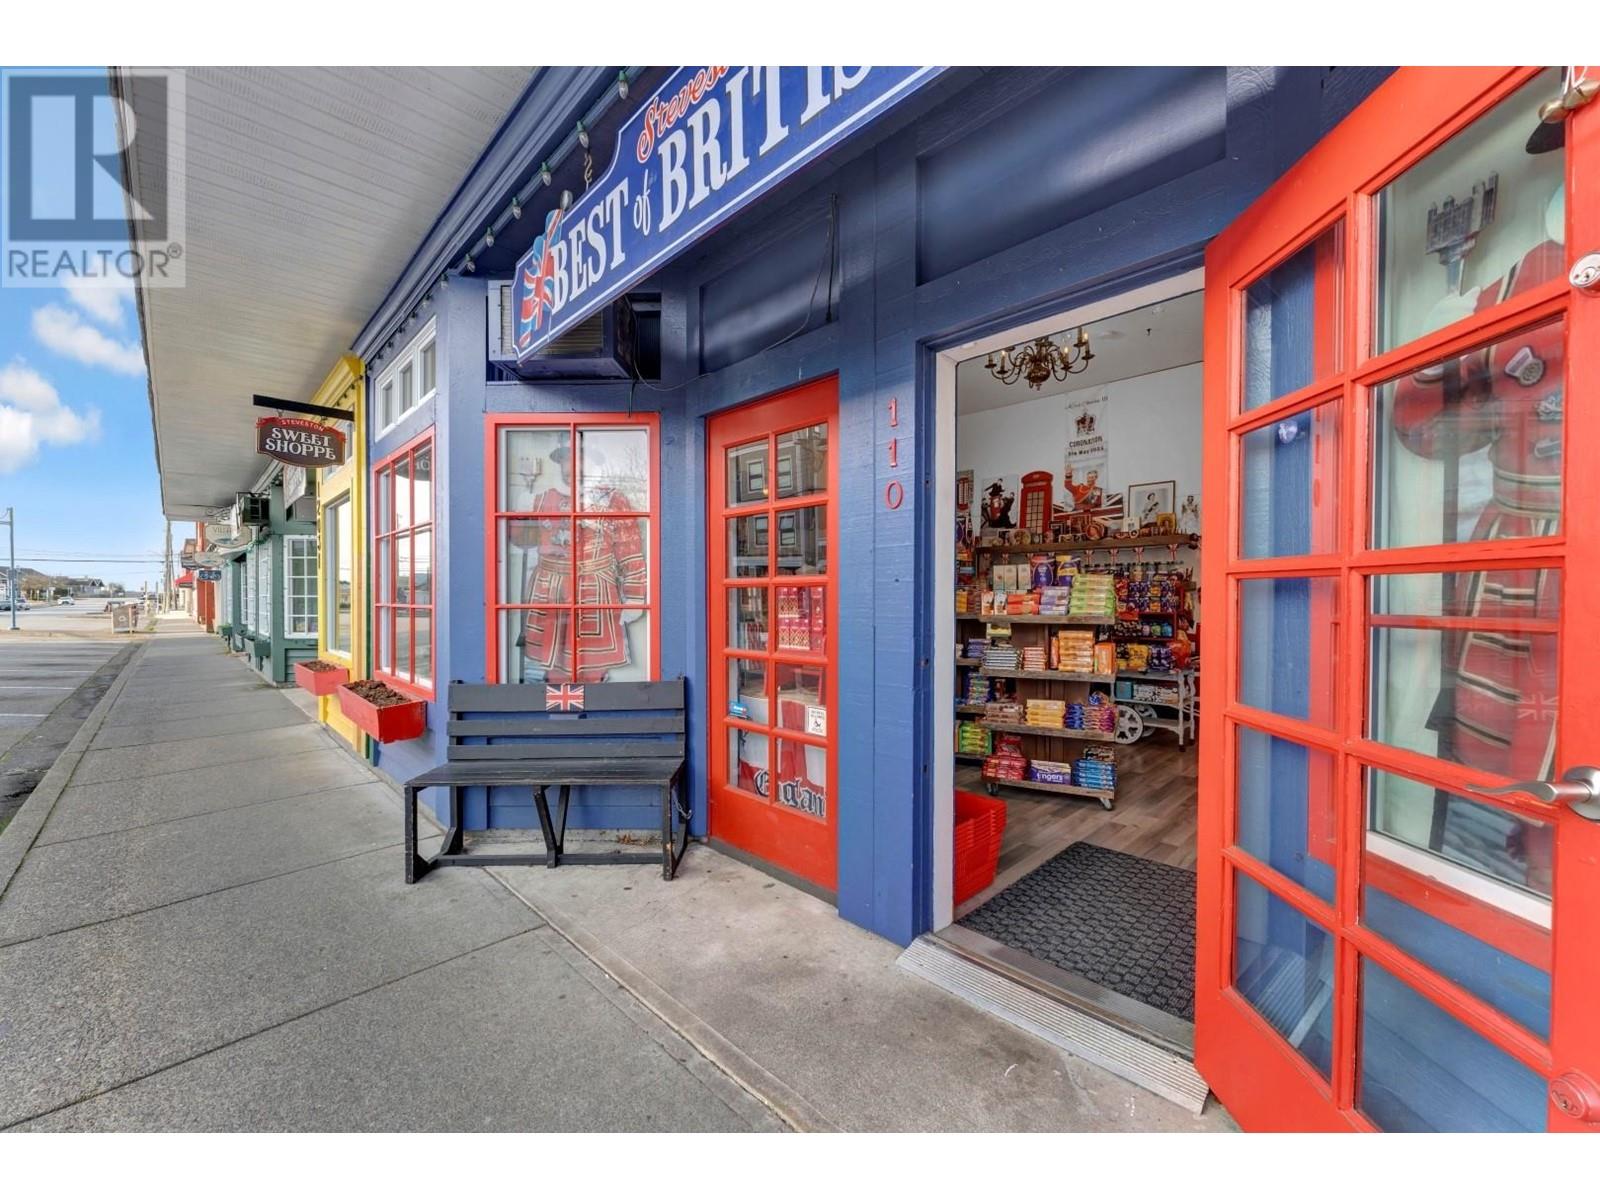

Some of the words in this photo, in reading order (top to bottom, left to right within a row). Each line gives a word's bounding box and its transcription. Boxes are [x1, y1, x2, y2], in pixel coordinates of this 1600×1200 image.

[550, 177, 629, 315] BEST
[633, 170, 651, 236] of
[658, 66, 872, 233] BRIT
[281, 419, 325, 432] STEVESTON
[271, 427, 331, 447] SWEET
[265, 438, 336, 460] SHOPPE
